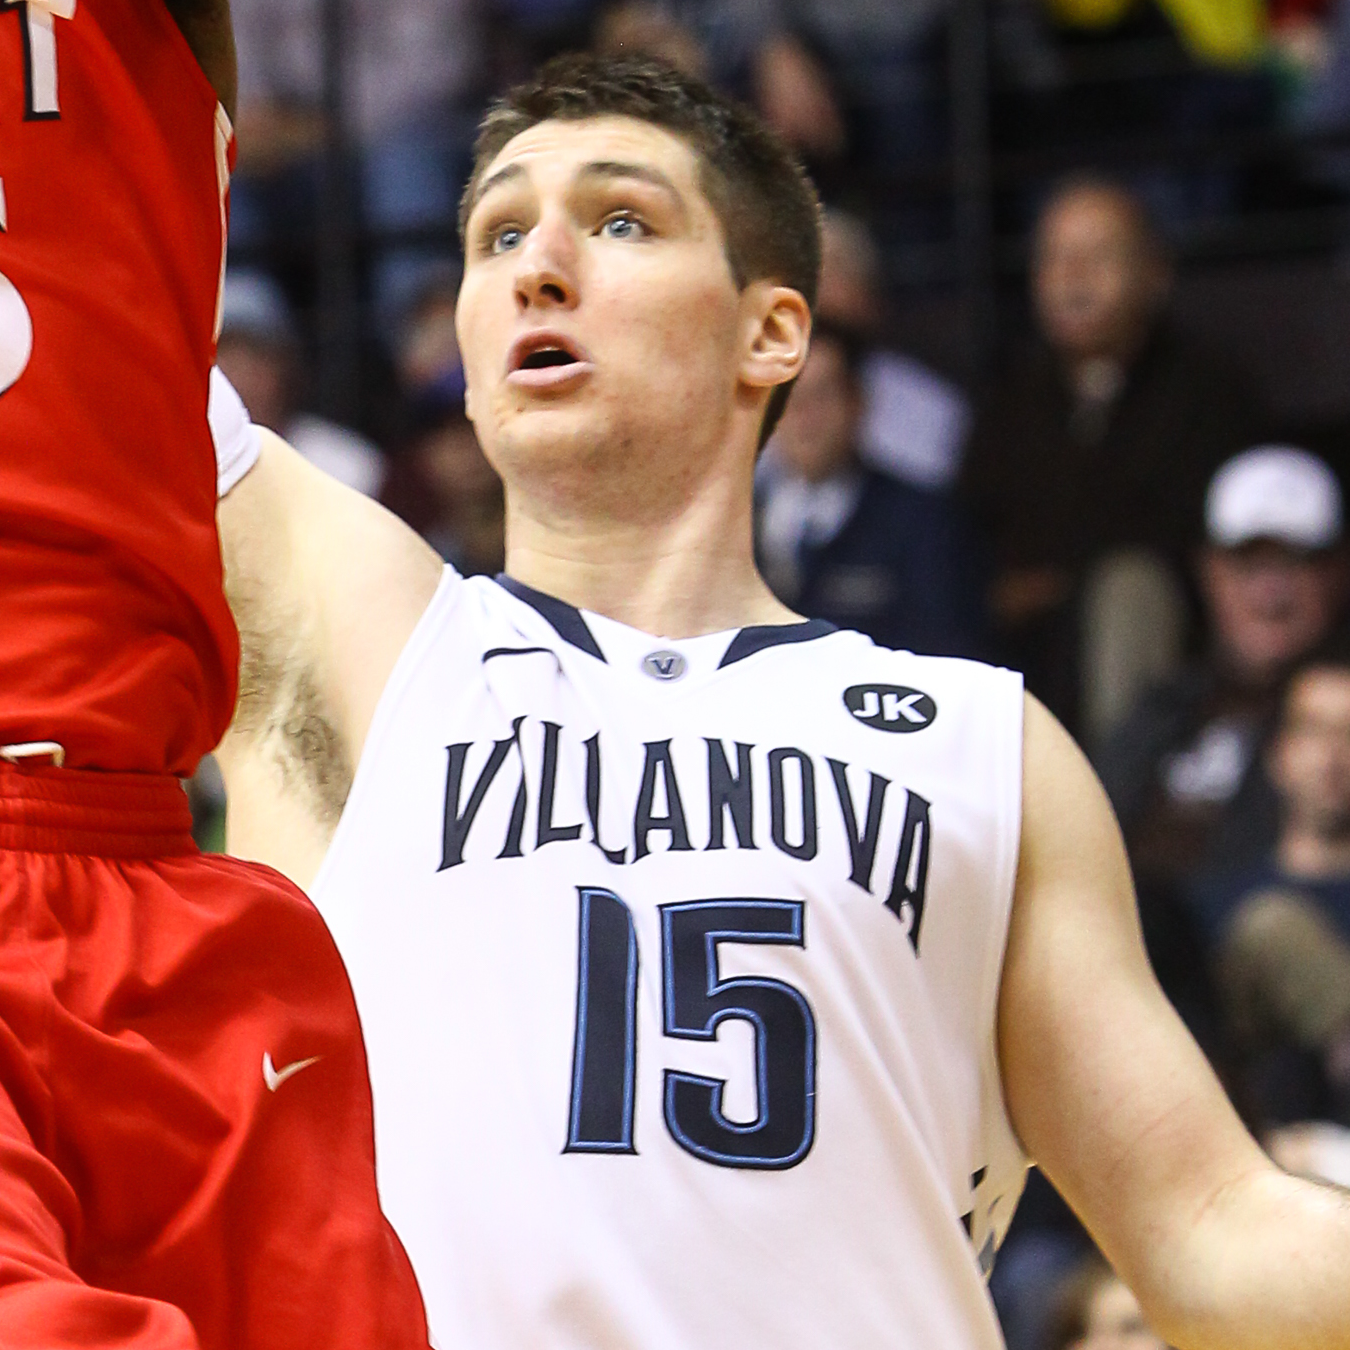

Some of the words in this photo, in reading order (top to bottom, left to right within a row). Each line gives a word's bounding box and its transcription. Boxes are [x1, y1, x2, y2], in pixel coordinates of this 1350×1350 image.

[852, 691, 929, 723] JK
[436, 715, 932, 959] VILLANOVA
[561, 885, 817, 1170] 15
